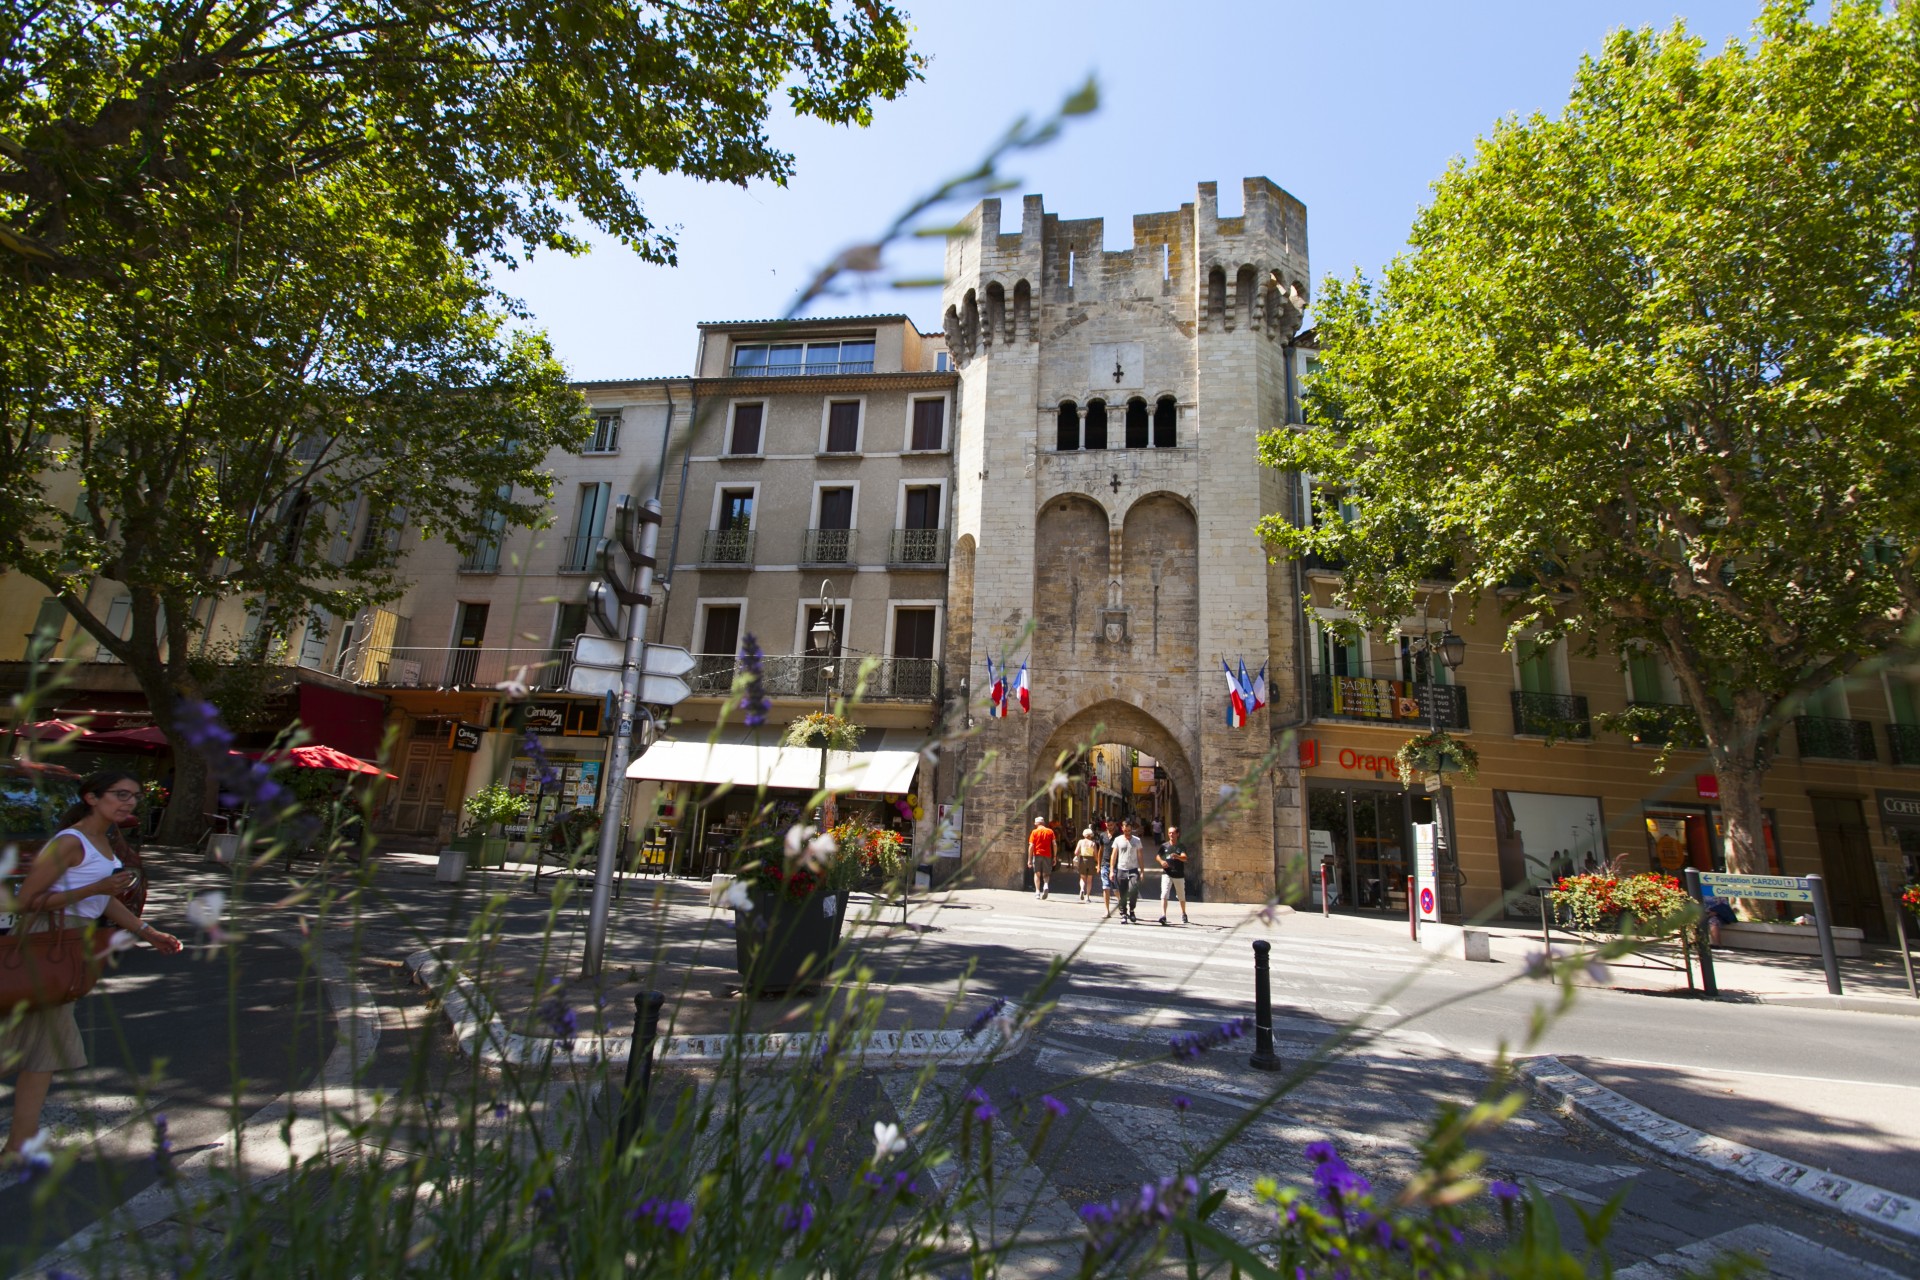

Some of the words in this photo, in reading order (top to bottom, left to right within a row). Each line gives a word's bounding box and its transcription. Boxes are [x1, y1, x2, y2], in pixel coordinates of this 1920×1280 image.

[524, 705, 557, 718] Century
[551, 714, 563, 726] 21
[471, 736, 478, 745] 21
[1338, 748, 1416, 778] Orang
[1715, 876, 1751, 884] Fondation
[1752, 877, 1784, 886] CARZOU
[1716, 888, 1743, 897] Collège
[1773, 890, 1789, 898] d'Or
